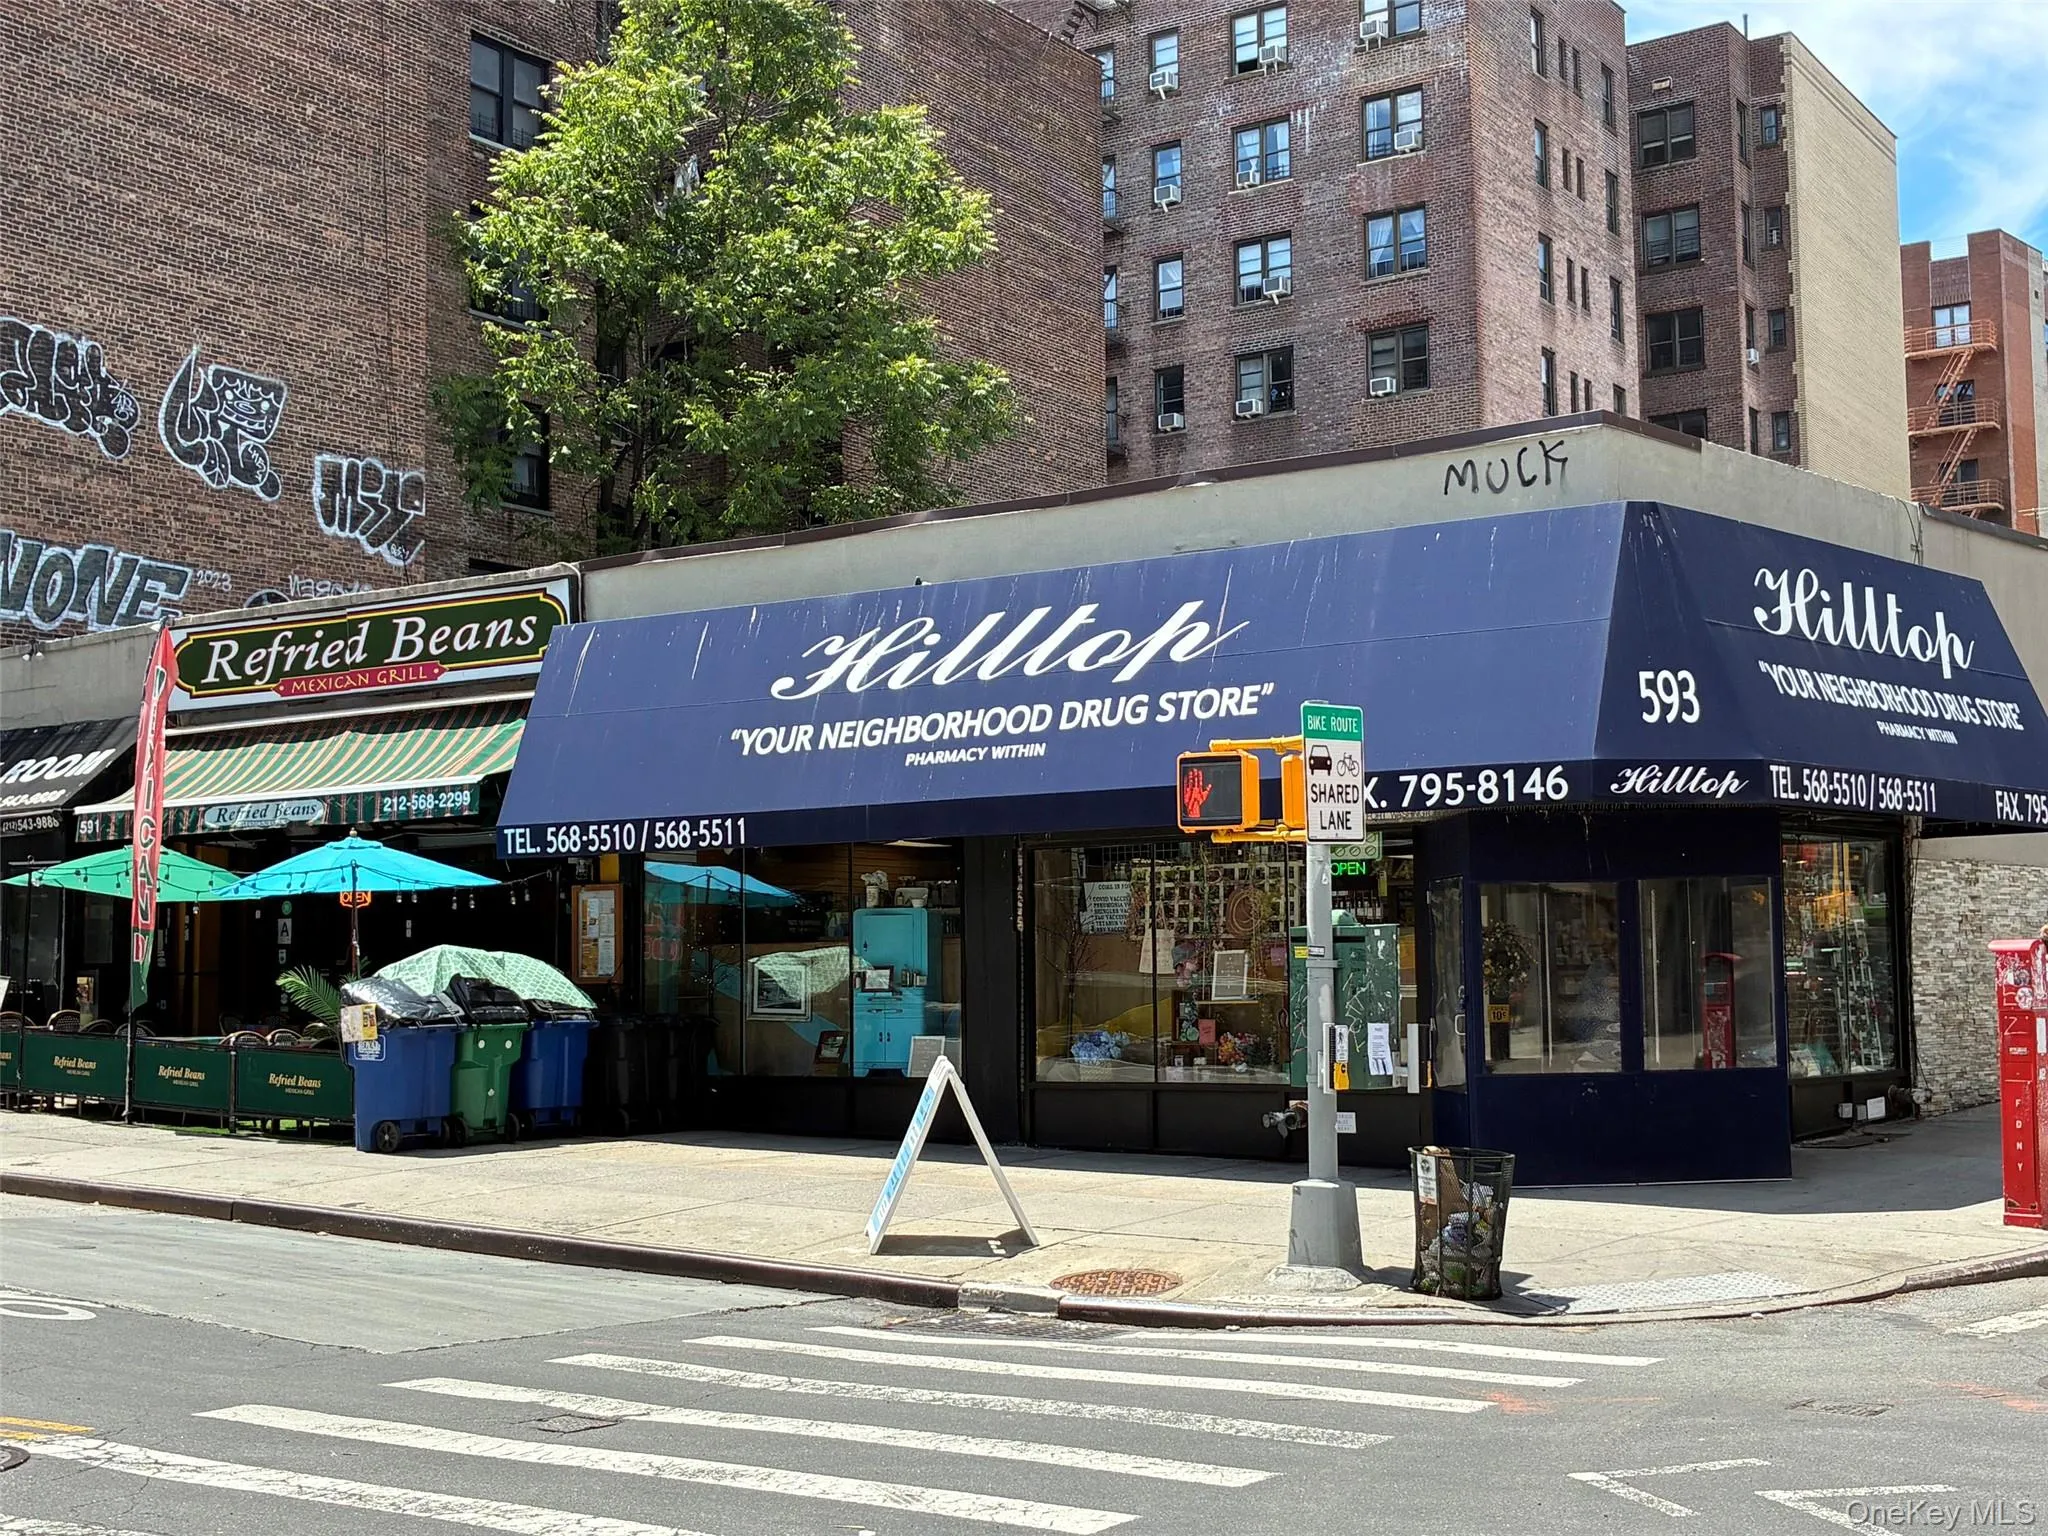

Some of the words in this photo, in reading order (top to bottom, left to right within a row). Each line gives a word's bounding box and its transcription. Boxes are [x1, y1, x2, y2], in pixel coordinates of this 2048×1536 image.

[1443, 439, 1569, 496] MUCK
[1752, 566, 1975, 680] Hilltop
[201, 620, 371, 686] Refried
[384, 614, 538, 664] Beans
[769, 599, 1252, 701] Hilltop
[291, 671, 370, 694] MEXICAN
[376, 665, 428, 684] GRILL
[1638, 669, 1702, 725] 593
[1813, 672, 1939, 719] NEIGHBORHOOD
[1933, 691, 1983, 725] DRUG
[819, 703, 1053, 751] NEIGHBORHOOD
[1057, 694, 1149, 731] DRUG
[1307, 714, 1328, 732] BIKE
[1330, 716, 1359, 734] ROUTE
[1876, 720, 1926, 741] PHARMACY
[1926, 728, 1959, 745] WITHIN
[0, 748, 117, 784] ROOM
[904, 747, 986, 768] PHARMACY
[990, 742, 1047, 761] WITHIN
[1310, 783, 1360, 805] SHARED
[1399, 765, 1569, 808] 795-8146
[1609, 764, 1751, 799] Hilltop
[1769, 764, 1800, 800] TEL.
[1802, 768, 1868, 808] 568-5510
[1878, 780, 1937, 814] 568-5511
[214, 803, 270, 823] Refried
[382, 791, 472, 813] 212-568-2299
[1994, 790, 2024, 822] FAX.
[79, 818, 101, 834] 591
[504, 828, 541, 855] TEL.
[546, 822, 636, 854] 568-5510
[640, 820, 650, 852] /
[653, 817, 746, 850] 568-5511
[1319, 810, 1353, 831] LANE
[1330, 861, 1366, 876] OPEN
[341, 891, 370, 903] OEN
[158, 1065, 184, 1080] Refried
[268, 1072, 297, 1088] Refried
[297, 1075, 322, 1089] Beans
[2015, 1098, 2023, 1172] FDNY
